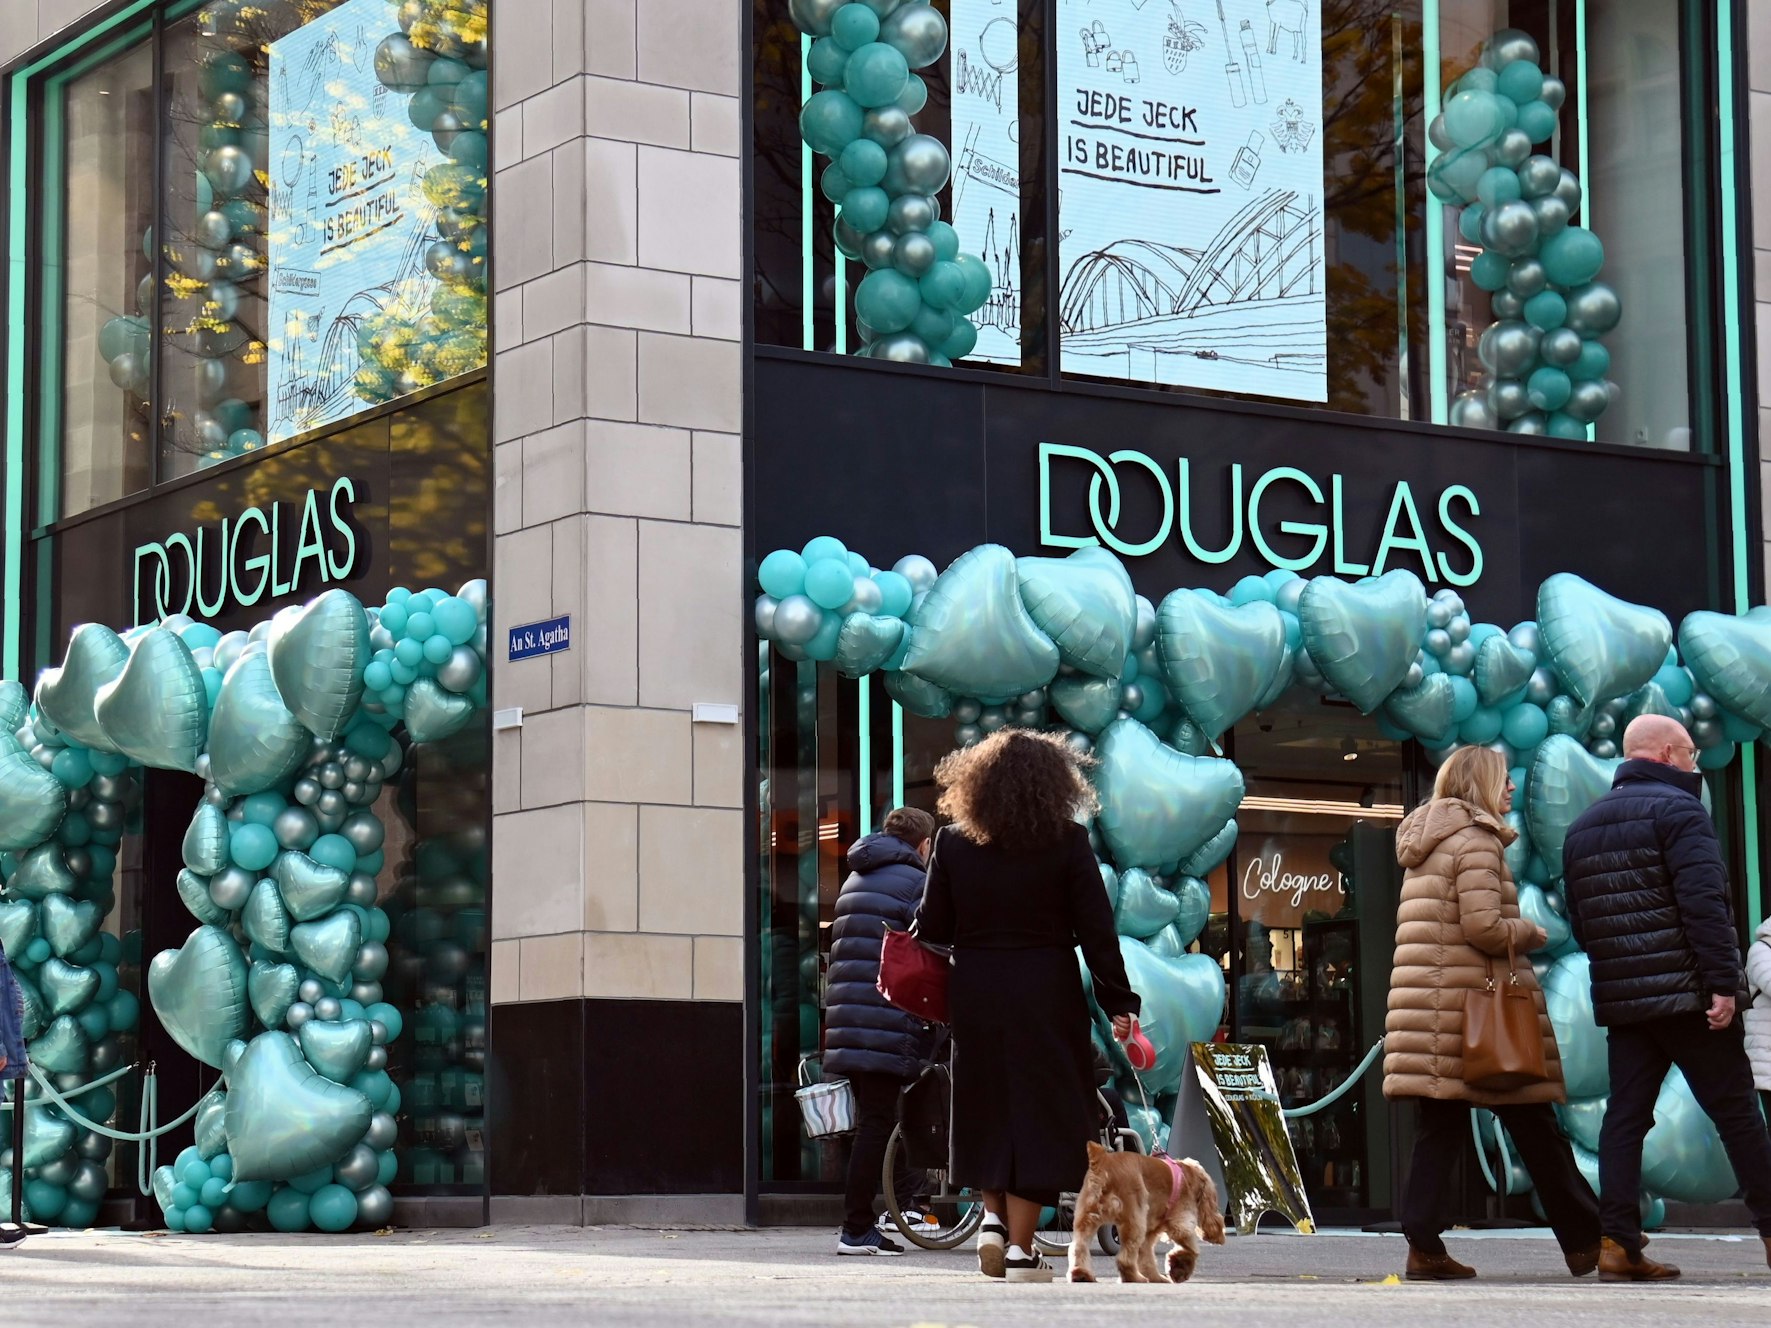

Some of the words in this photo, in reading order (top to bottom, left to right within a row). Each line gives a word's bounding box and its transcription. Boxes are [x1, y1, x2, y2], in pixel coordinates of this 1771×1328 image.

[1076, 88, 1132, 123] JEDE
[1142, 100, 1198, 133] JECK
[328, 161, 357, 195] JEDE
[362, 145, 392, 180] JECK
[1067, 135, 1088, 164] IS
[1095, 141, 1213, 183] BEAUTIFUL
[323, 218, 334, 244] IS
[337, 191, 400, 240] BEAUTIFUL
[1039, 442, 1483, 586] DOUGLAS
[134, 476, 355, 628] DOUGLAS
[510, 635, 523, 652] An
[524, 631, 536, 649] St.
[538, 624, 568, 650] Agatha
[1243, 853, 1333, 907] Cologne
[1213, 1054, 1232, 1066] JEDE
[1233, 1054, 1252, 1066] JECK
[1215, 1073, 1225, 1086] IS
[1225, 1073, 1263, 1087] BEAUTIFUL
